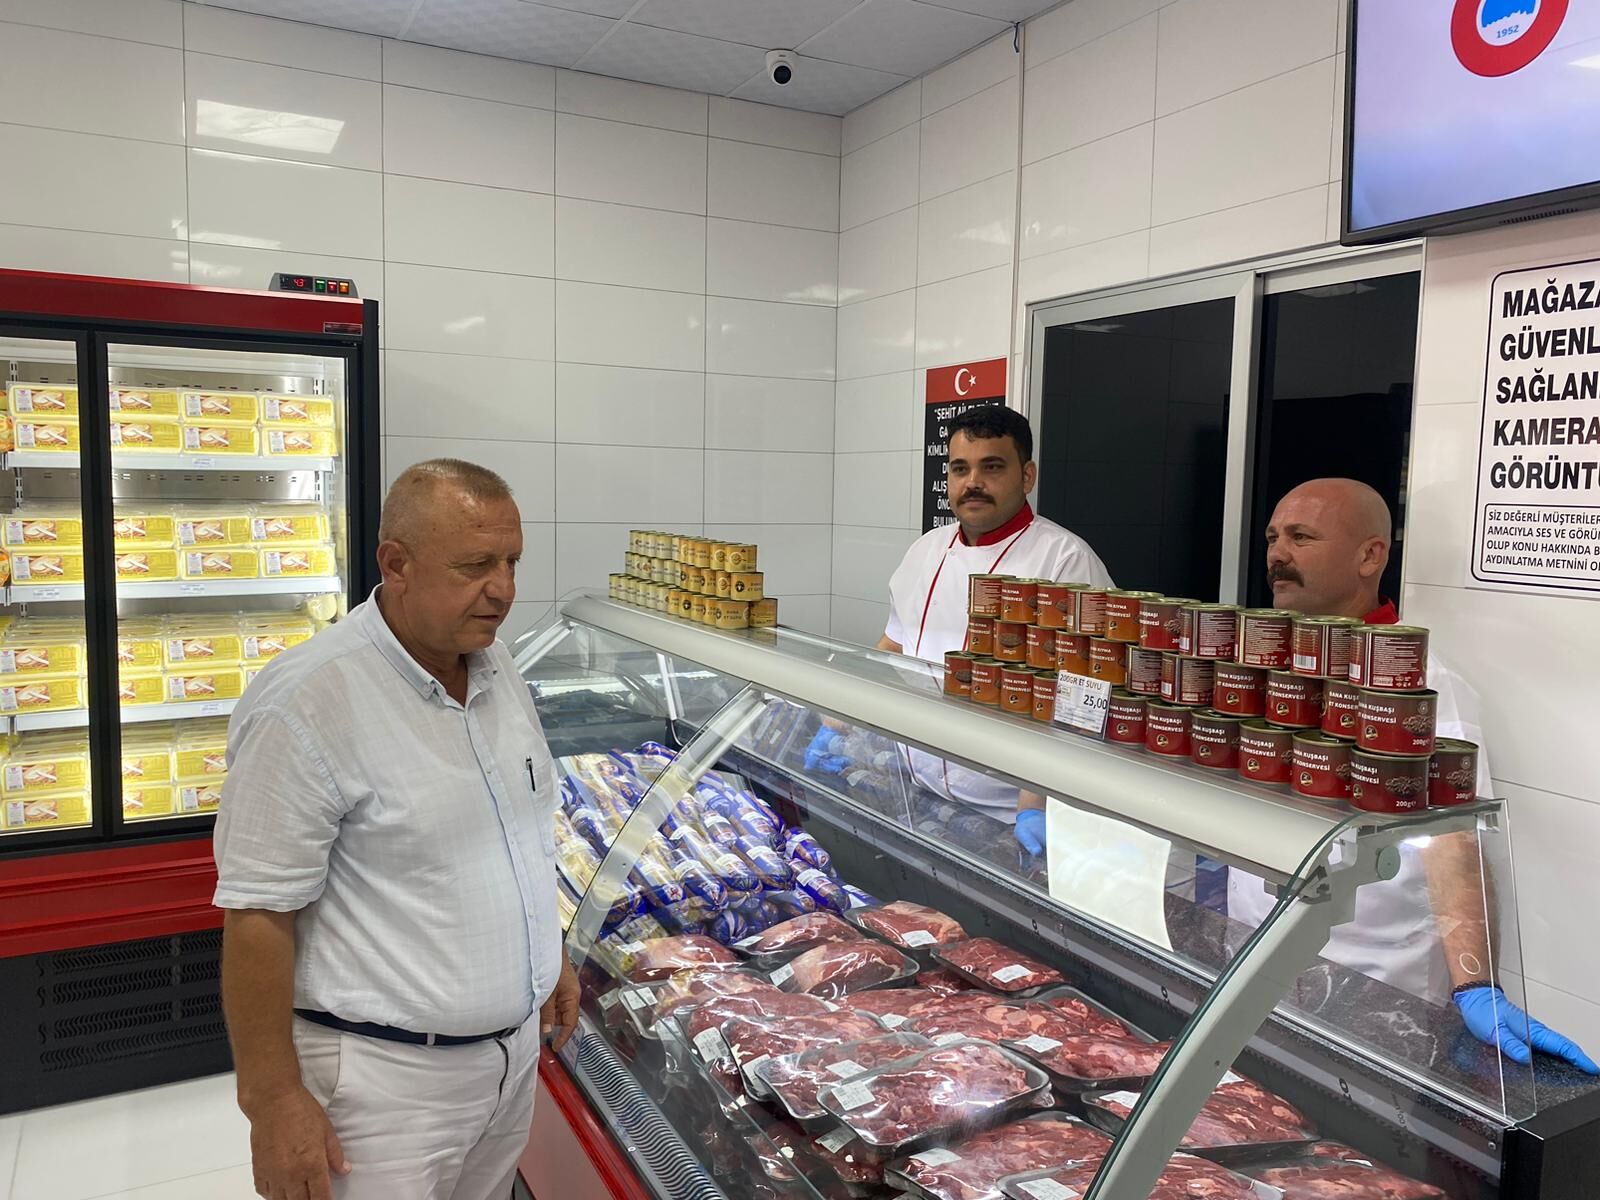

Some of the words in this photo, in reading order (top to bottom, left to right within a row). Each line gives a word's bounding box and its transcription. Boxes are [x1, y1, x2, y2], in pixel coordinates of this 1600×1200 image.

[1496, 24, 1519, 38] 1952
[1500, 326, 1600, 361] GÜVENL
[1496, 368, 1600, 404] SAĞLAN
[1493, 417, 1600, 446] KAMERA
[1490, 455, 1600, 489] GÖRÜNT
[1489, 510, 1501, 521] SİZ
[1504, 510, 1540, 522] DEĞERLİ
[1543, 512, 1600, 525] MÜŞTERİLER
[1488, 526, 1533, 537] AMACIYLA
[1536, 528, 1551, 538] SES
[1555, 529, 1566, 538] VE
[1487, 540, 1510, 550] OLUP
[1512, 542, 1538, 552] KONU
[1541, 544, 1591, 555] HAKKINDA
[1486, 555, 1543, 567] AYDINLATMA
[1546, 557, 1588, 570] METNİNİ
[1079, 678, 1085, 686] ET
[1086, 680, 1102, 690] SUYU
[1279, 683, 1304, 691] KUŞBAŞI
[1272, 691, 1305, 700] KONSERVESİ
[1084, 695, 1108, 710] 25,00
[1368, 704, 1394, 714] KUŞBAŞI
[1160, 716, 1182, 725] KUŞBAŞI
[1153, 724, 1183, 732] KONSERVESİ
[1202, 727, 1225, 735] KUŞBAŞI
[1196, 734, 1226, 744] KONSERVESİ
[1250, 739, 1274, 748] KUŞBAŞI
[1244, 746, 1276, 757] KONSERVESİ
[1303, 753, 1329, 762] KUŞBAŞI
[1297, 759, 1330, 771] KONSERVESİ
